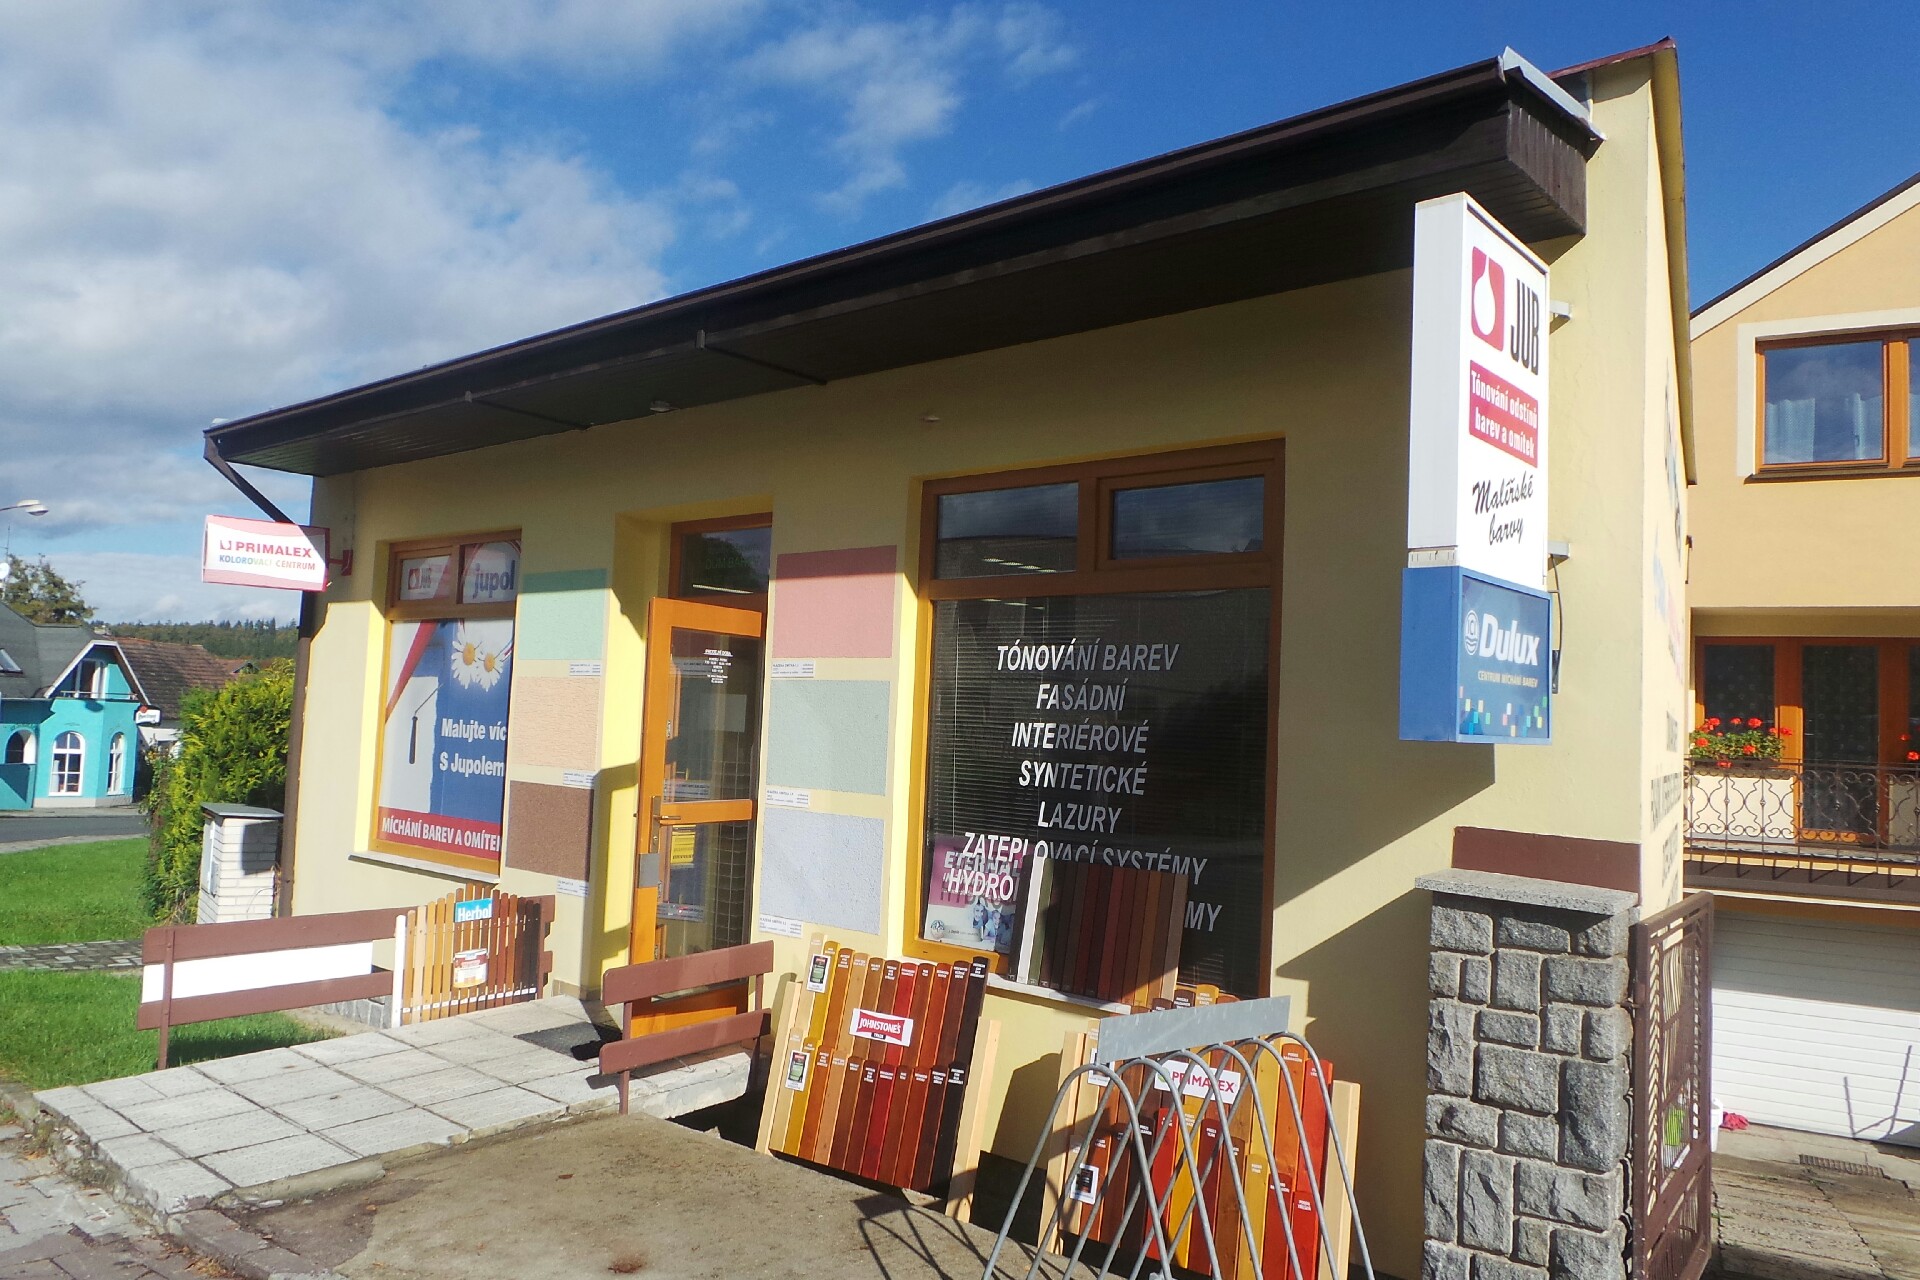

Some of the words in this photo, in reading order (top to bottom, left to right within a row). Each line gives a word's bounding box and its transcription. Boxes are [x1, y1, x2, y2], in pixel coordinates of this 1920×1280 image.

[1510, 277, 1540, 376] JUB
[1471, 369, 1509, 412] Tónování
[1474, 406, 1501, 440] barev
[1501, 426, 1508, 444] a
[1508, 428, 1535, 459] omítek
[1472, 469, 1534, 515] Malířské
[1488, 513, 1524, 546] barvy
[235, 541, 312, 558] PRIMALEX
[275, 560, 316, 571] CENTRUM
[472, 559, 515, 600] jupol
[997, 637, 1100, 671] TÓNOVÁNÍ
[1102, 643, 1180, 671] BAREV
[1479, 613, 1540, 666] Dulux
[1036, 677, 1129, 711] FASÁDNÍ
[441, 717, 486, 743] Malujte
[1011, 717, 1149, 754] INTERIÉROVÉ
[439, 751, 449, 771] S
[450, 752, 505, 778] Jupolem
[1018, 760, 1148, 796] SYNTETICKÉ
[382, 815, 423, 839] MÍCHÁNÍ
[422, 823, 454, 845] BAREV
[454, 829, 463, 846] A
[1037, 801, 1123, 834] LAZURY
[457, 902, 493, 922] Herbol
[1171, 1071, 1235, 1094] PRIMAEX
